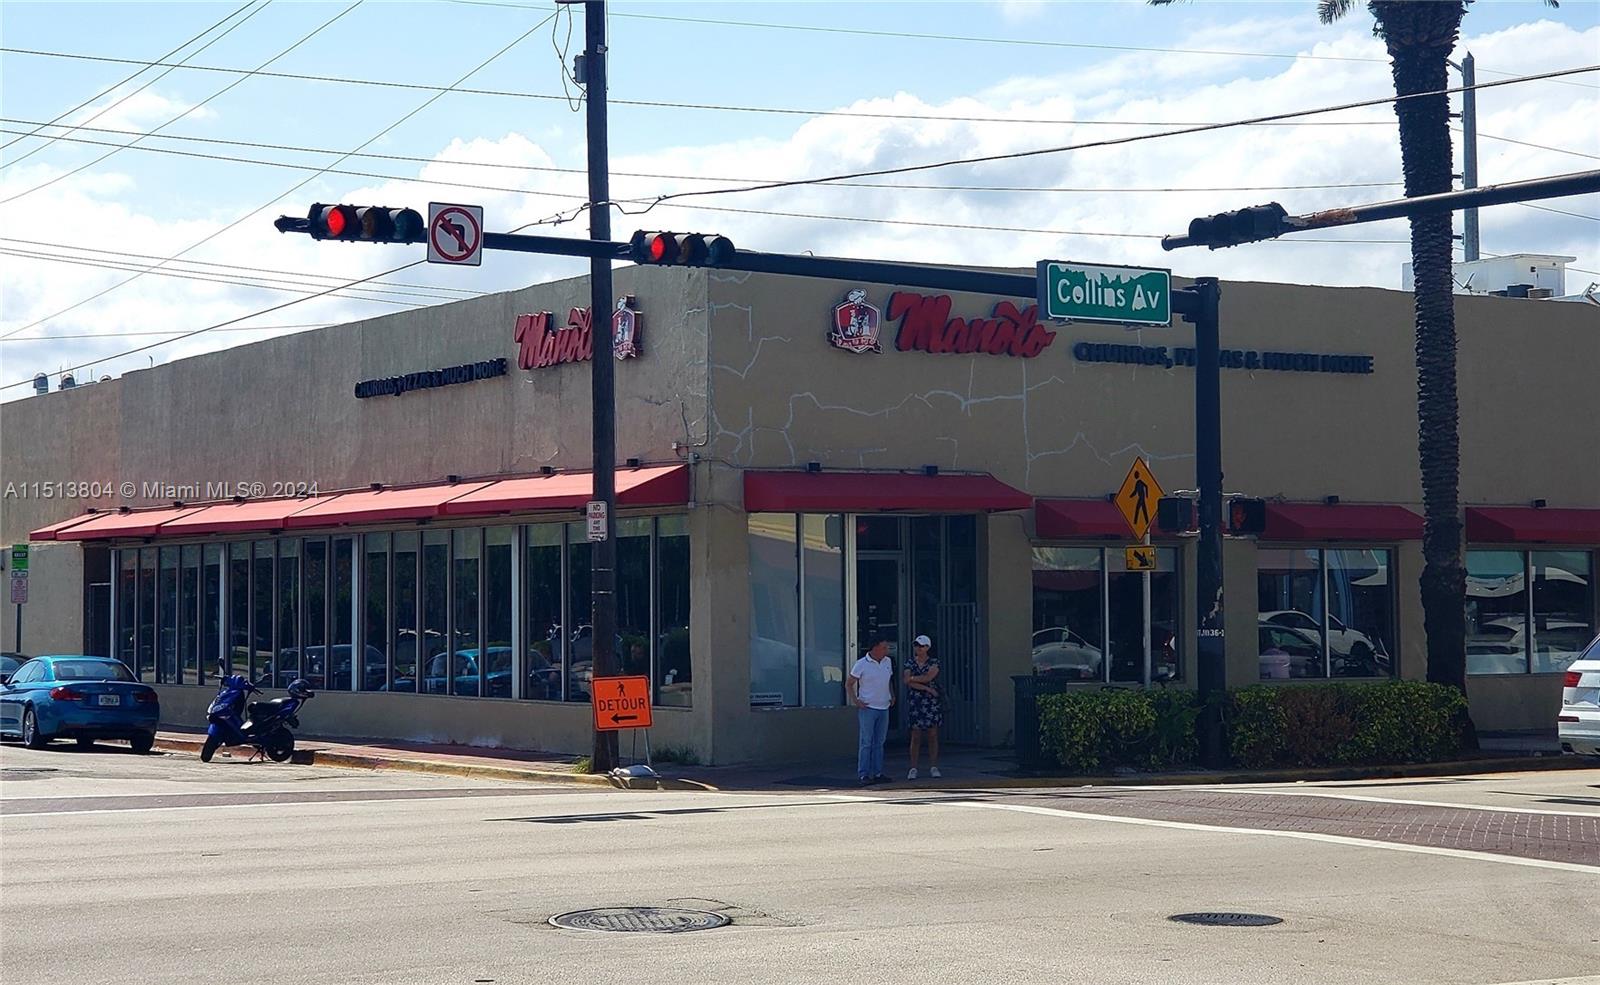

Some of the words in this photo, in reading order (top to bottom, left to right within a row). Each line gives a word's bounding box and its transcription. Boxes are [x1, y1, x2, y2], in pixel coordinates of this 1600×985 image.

[1057, 278, 1126, 307] Collins
[1132, 284, 1160, 311] Av
[1174, 347, 1243, 369] PIAS
[1244, 350, 1261, 370] &
[1263, 351, 1319, 372] MUCH
[1320, 354, 1374, 374] MORE
[599, 698, 646, 711] DETOUR
